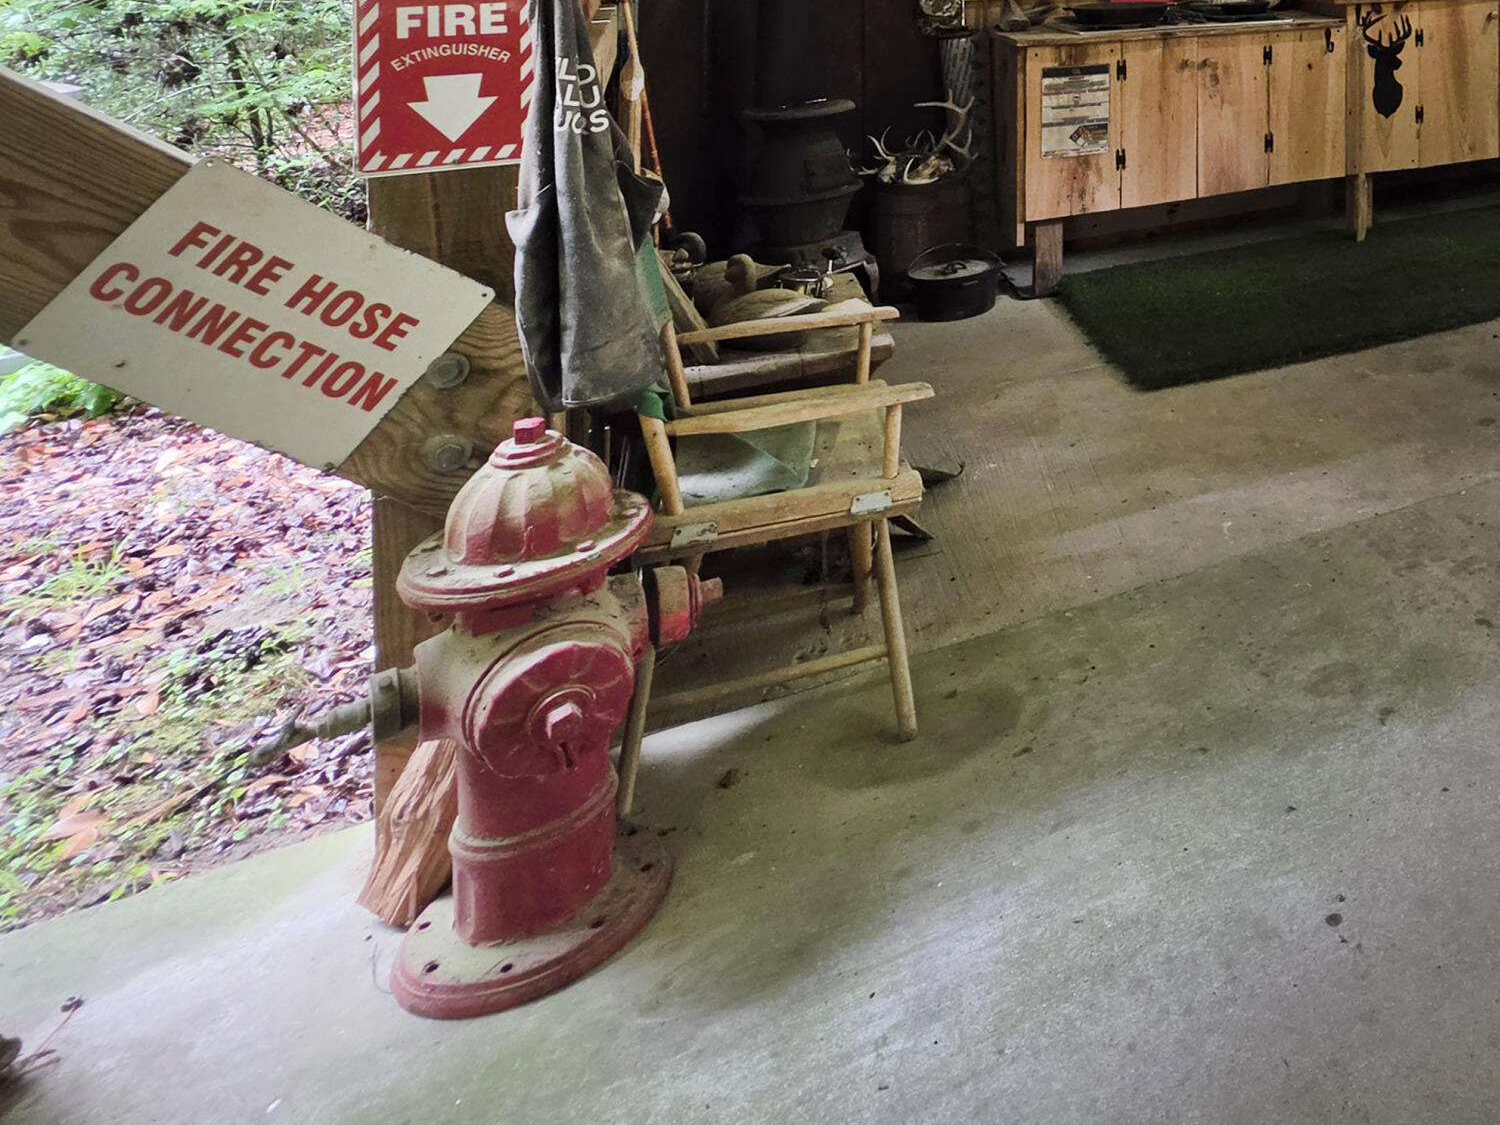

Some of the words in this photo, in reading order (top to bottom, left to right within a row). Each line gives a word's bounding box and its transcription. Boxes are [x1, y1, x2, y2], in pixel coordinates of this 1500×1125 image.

[390, 43, 512, 72] EXTINGUISHER
[396, 2, 508, 39] FIRE
[168, 221, 294, 296] FIRE
[284, 274, 420, 352] HOSE
[89, 262, 399, 412] CONNECTION
